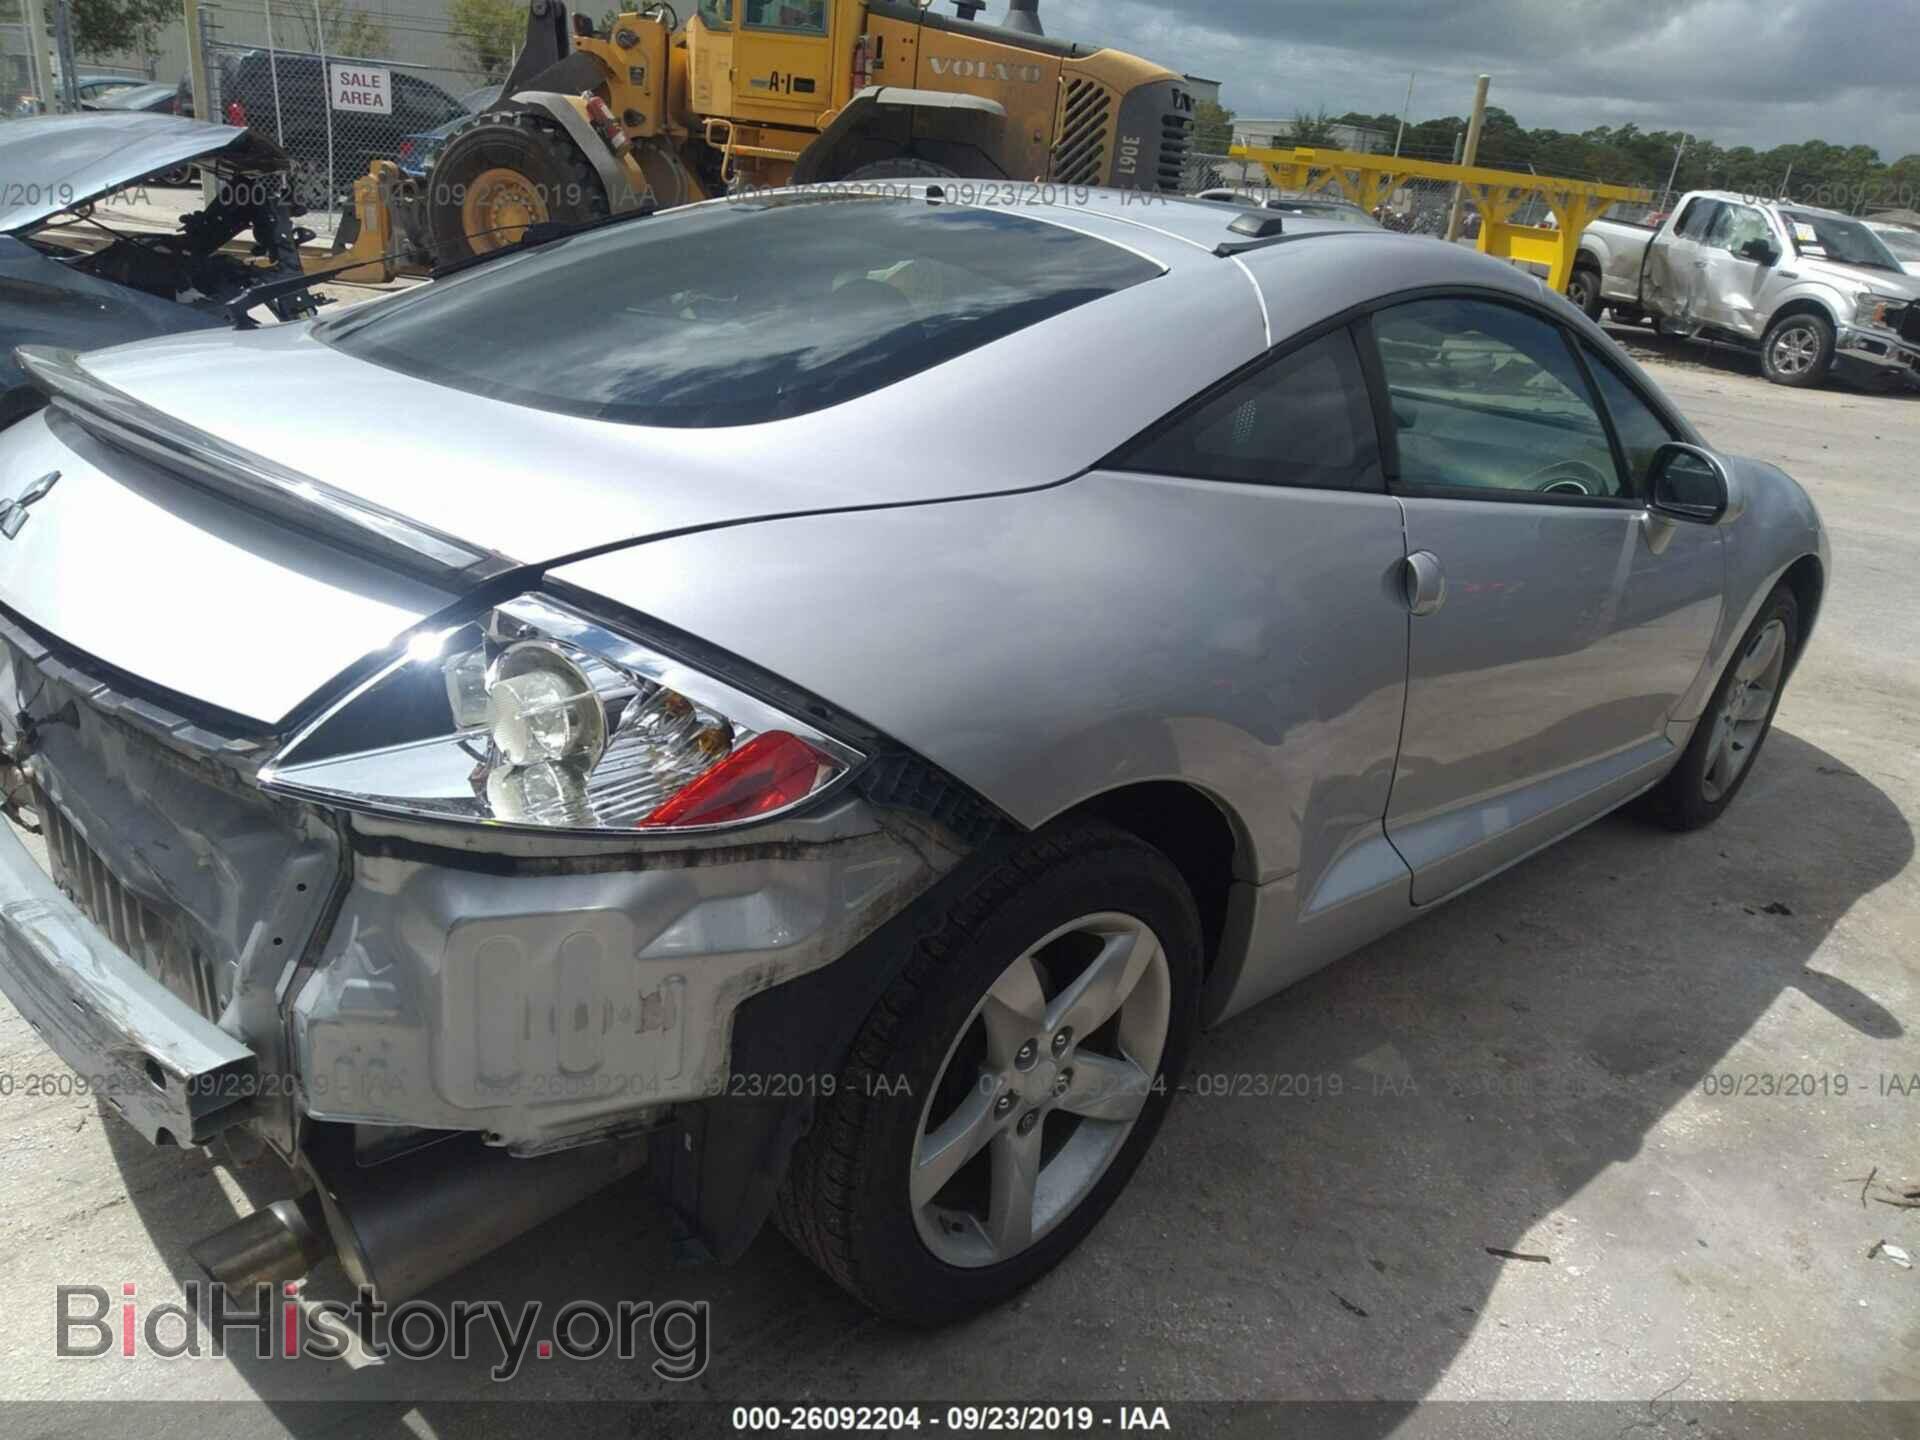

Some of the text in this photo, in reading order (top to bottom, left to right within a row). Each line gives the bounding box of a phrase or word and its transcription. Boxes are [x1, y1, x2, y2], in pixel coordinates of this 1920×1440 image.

[340, 71, 383, 88] SALE
[929, 57, 1042, 82] VOLVO
[340, 91, 384, 107] AREA
[1119, 135, 1140, 175] L90E
